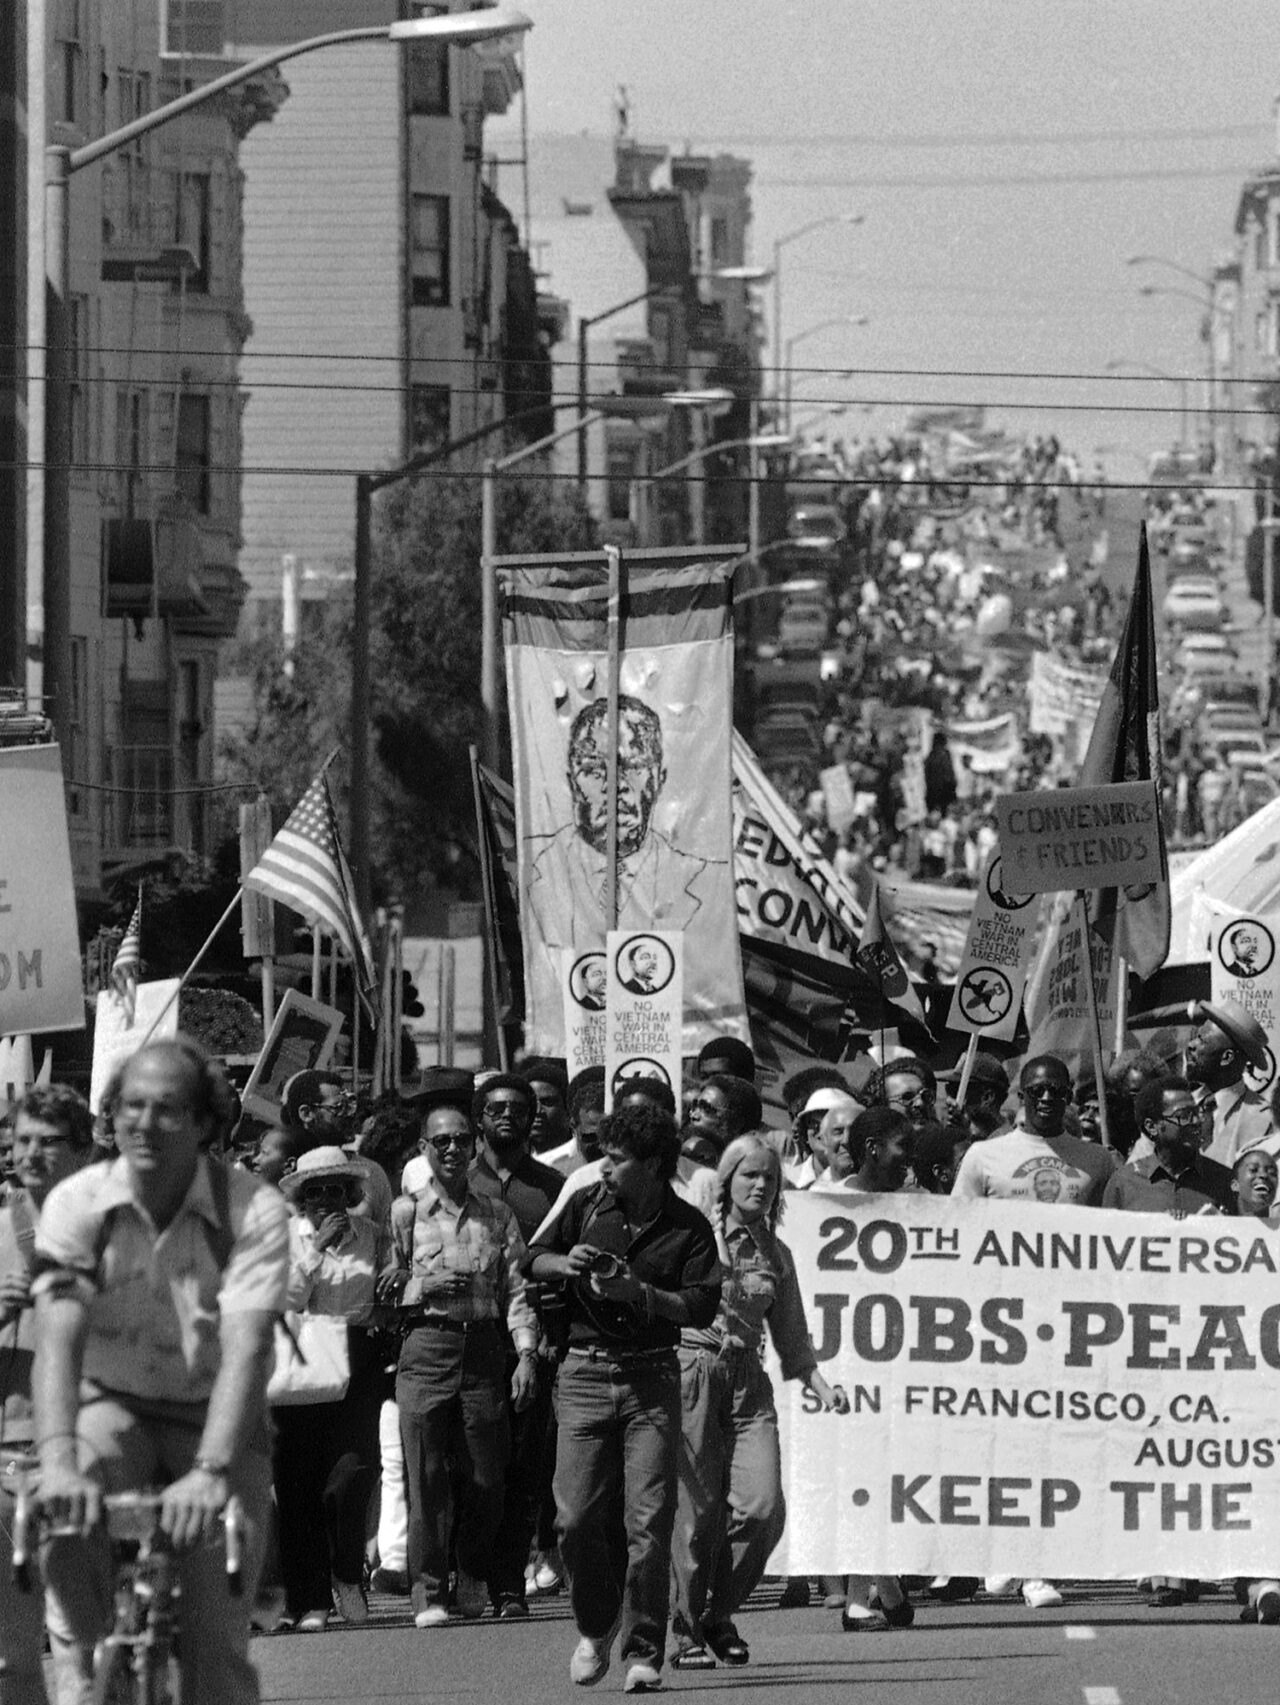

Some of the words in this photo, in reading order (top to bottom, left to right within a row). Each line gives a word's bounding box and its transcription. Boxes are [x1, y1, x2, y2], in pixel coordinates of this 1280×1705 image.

[1037, 836, 1148, 869] FRIENDS
[994, 911, 1011, 923] NO
[977, 917, 1025, 937] VIETNAM
[981, 930, 1005, 942] WAR
[1007, 936, 1019, 946] IN
[971, 937, 1021, 958] CENTRAL
[970, 948, 1019, 968] AMERICA
[1237, 979, 1255, 990] NO
[1219, 989, 1274, 1000] VIETNAM
[633, 1000, 653, 1012] NO
[1257, 1000, 1268, 1009] IN
[614, 1011, 671, 1022] VIETNAM
[572, 1026, 607, 1036] VIETN
[622, 1021, 649, 1032] WAR
[653, 1022, 665, 1032] IN
[613, 1032, 672, 1043] CENTRAL
[615, 1043, 671, 1054] AMERICA
[816, 1215, 960, 1275] 20TH
[890, 1474, 1082, 1528] KEEP
[1109, 1481, 1253, 1532] THE
